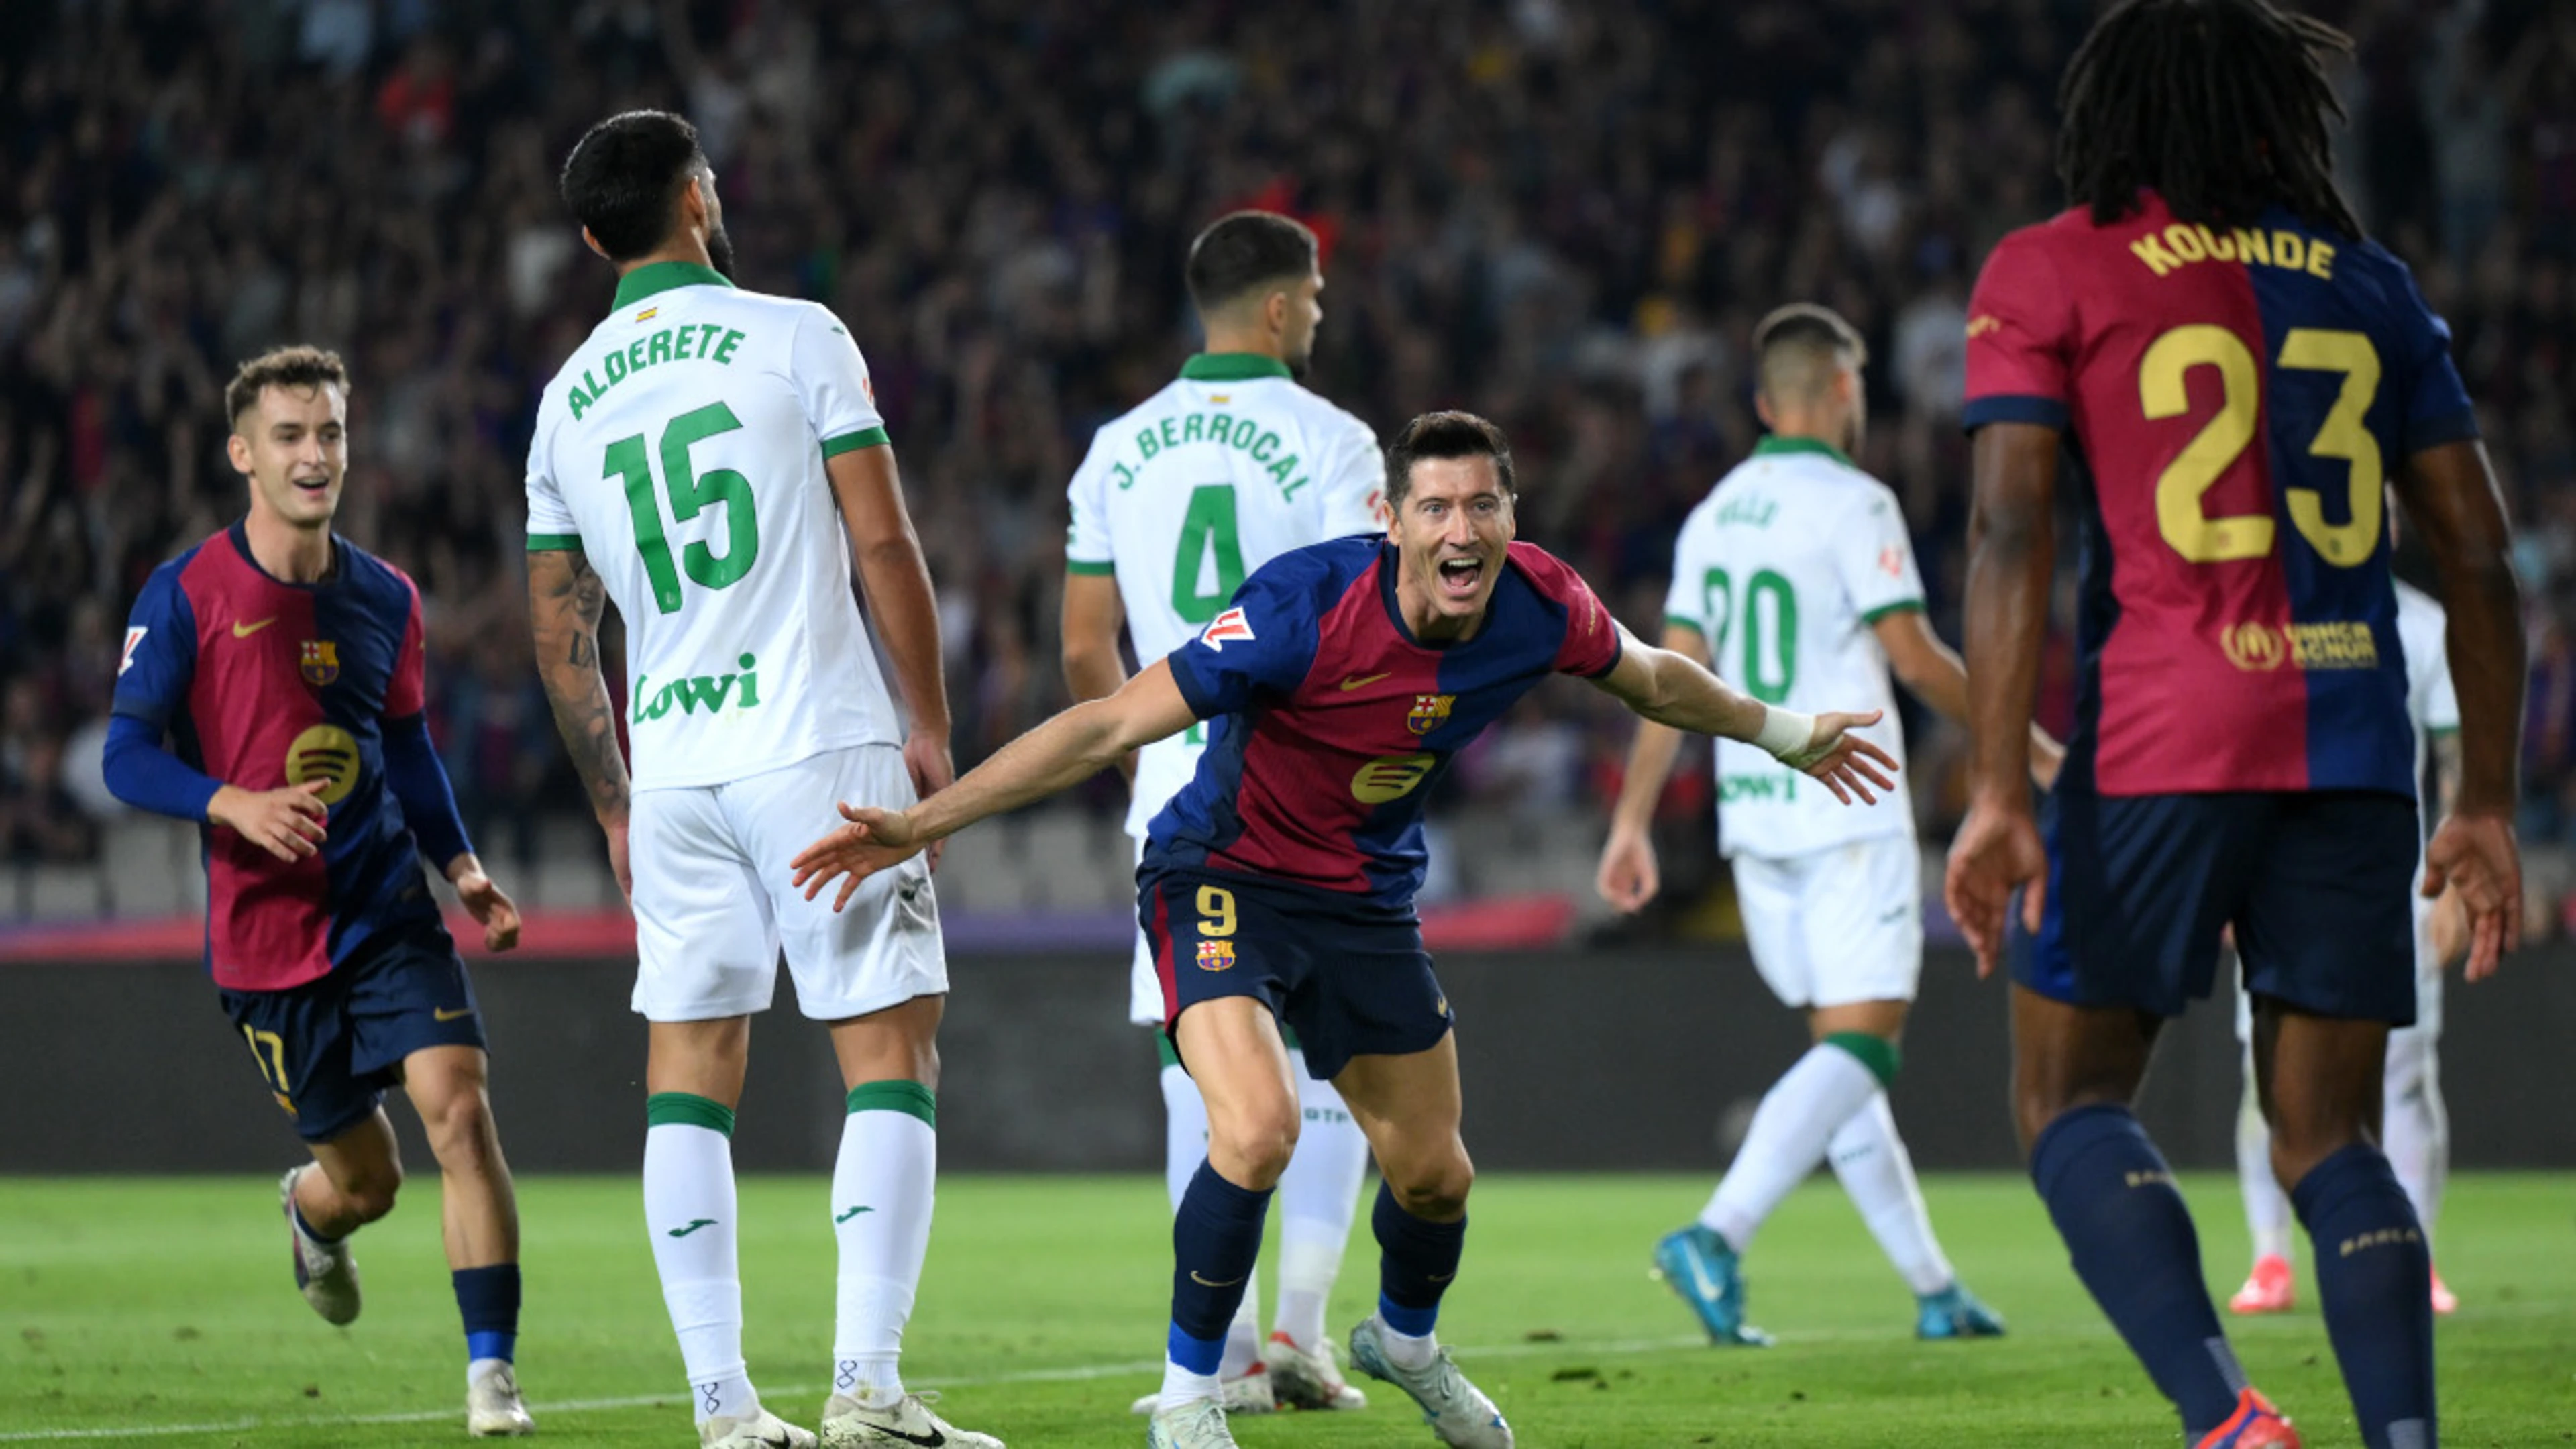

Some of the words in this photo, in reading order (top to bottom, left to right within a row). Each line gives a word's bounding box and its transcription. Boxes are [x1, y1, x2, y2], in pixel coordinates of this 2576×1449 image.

[568, 323, 746, 421] ALDERETE
[2139, 323, 2381, 567] 23
[602, 400, 759, 615] 15
[633, 651, 761, 725] Lowi
[1196, 884, 1237, 936] 9
[242, 1022, 290, 1092] 17
